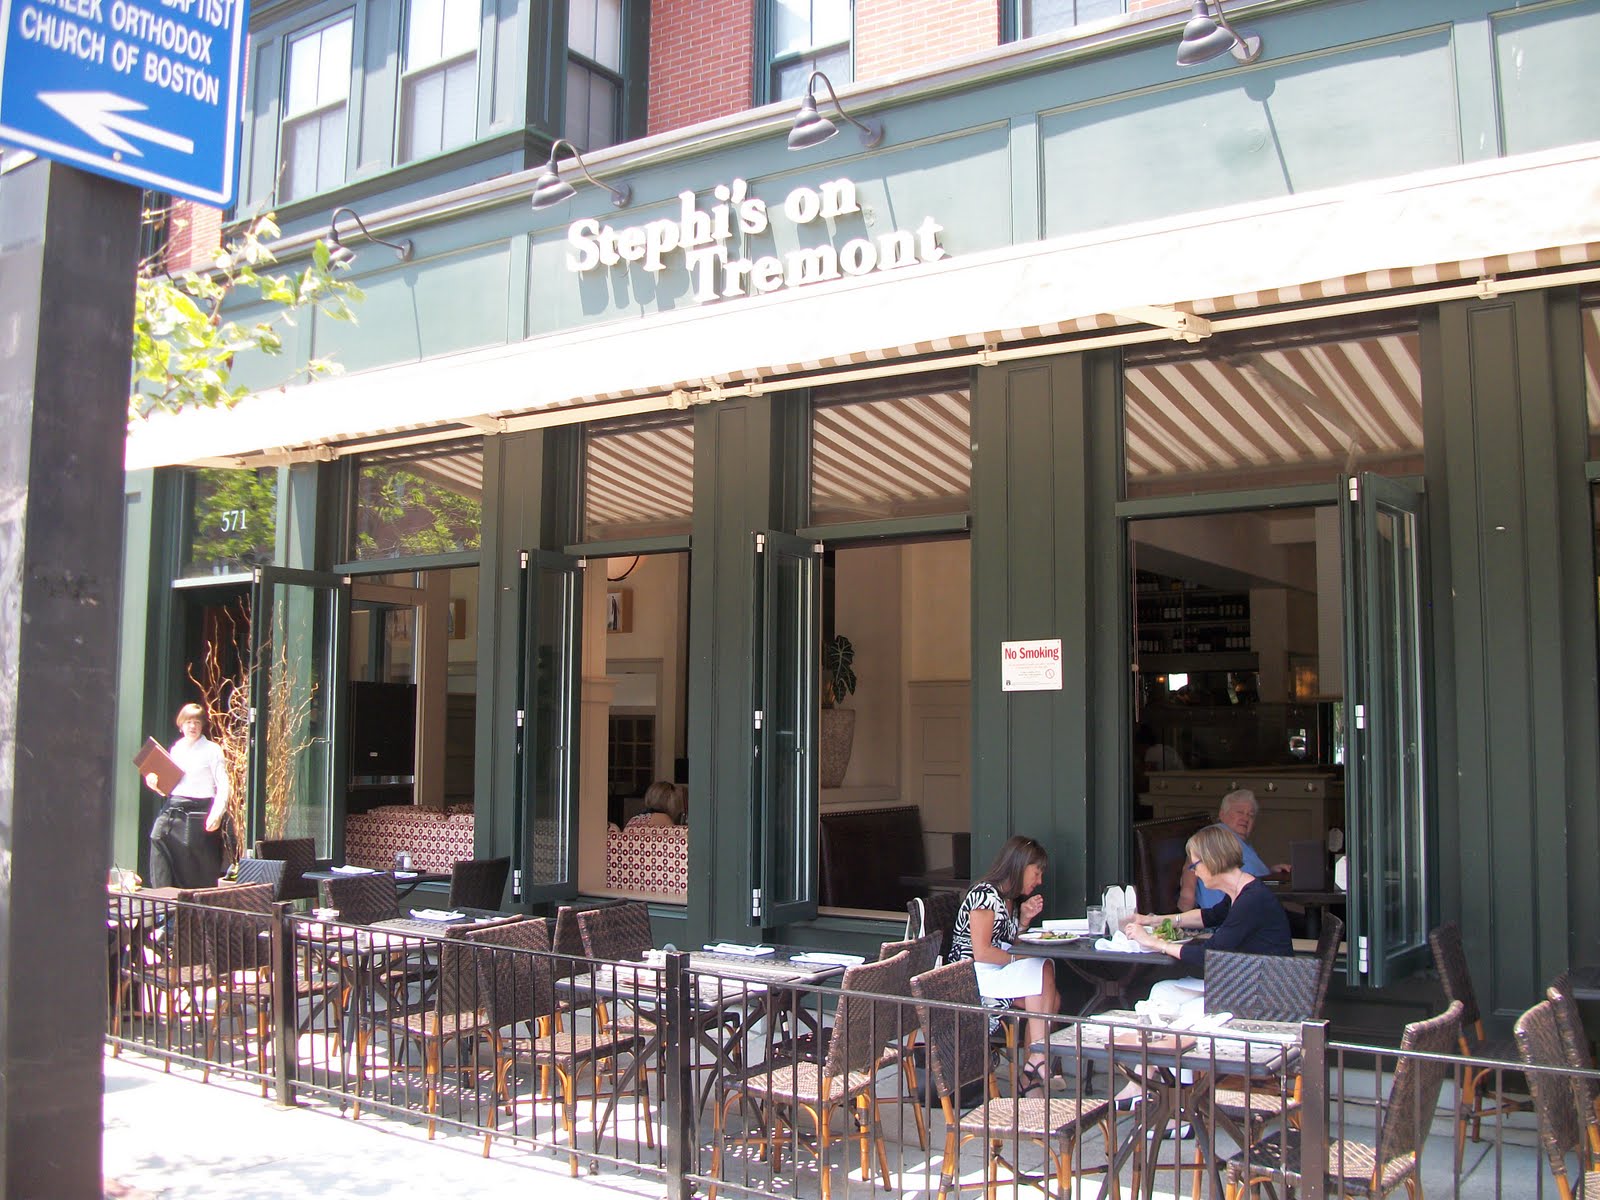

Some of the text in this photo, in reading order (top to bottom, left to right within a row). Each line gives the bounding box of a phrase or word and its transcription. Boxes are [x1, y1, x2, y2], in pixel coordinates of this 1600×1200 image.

[38, 0, 212, 65] EEK ORTHODOX
[161, 0, 234, 30] PTIST
[21, 7, 219, 106] CHURCH OF BOSTON
[566, 178, 861, 273] Stephi's on
[685, 215, 946, 302] Tremont
[221, 509, 247, 532] 571
[1005, 646, 1060, 661] No Smoking
